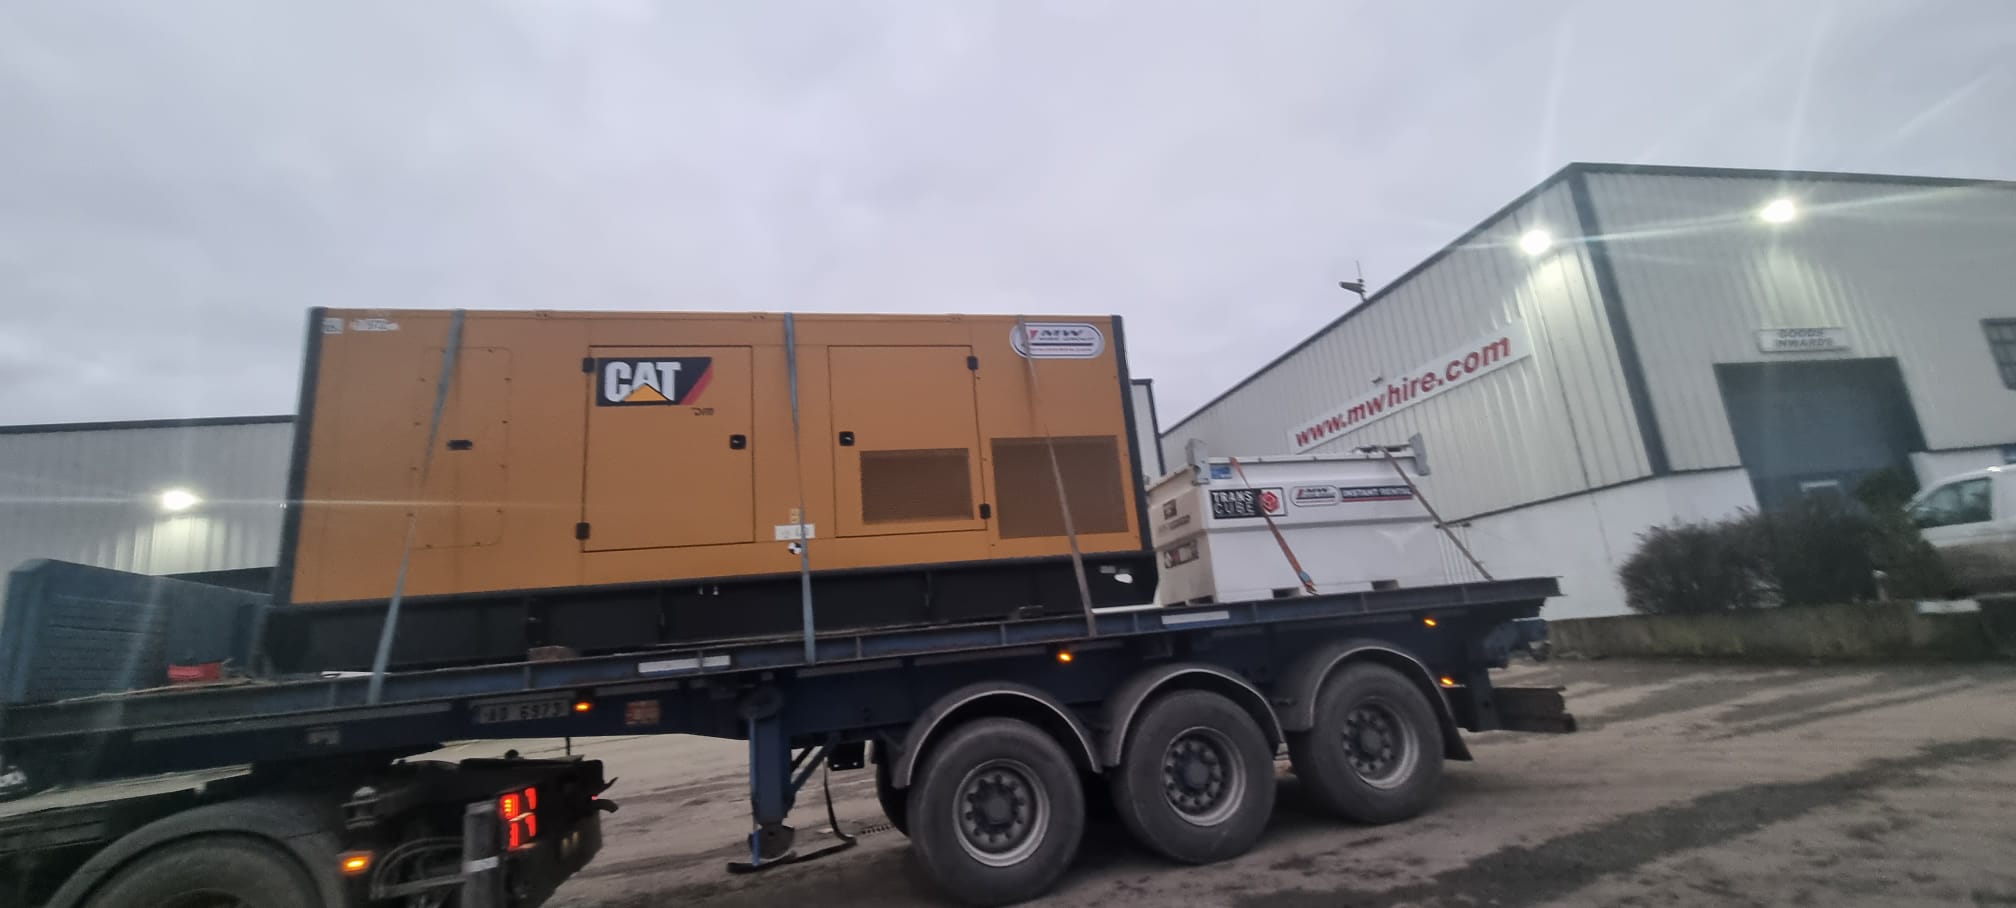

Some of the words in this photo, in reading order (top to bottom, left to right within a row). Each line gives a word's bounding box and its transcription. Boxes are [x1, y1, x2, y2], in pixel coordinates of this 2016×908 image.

[604, 361, 682, 402] CAT
[1295, 336, 1512, 447] www.mwhire.com
[1212, 491, 1254, 502] TRANS
[1213, 502, 1256, 514] CUBE
